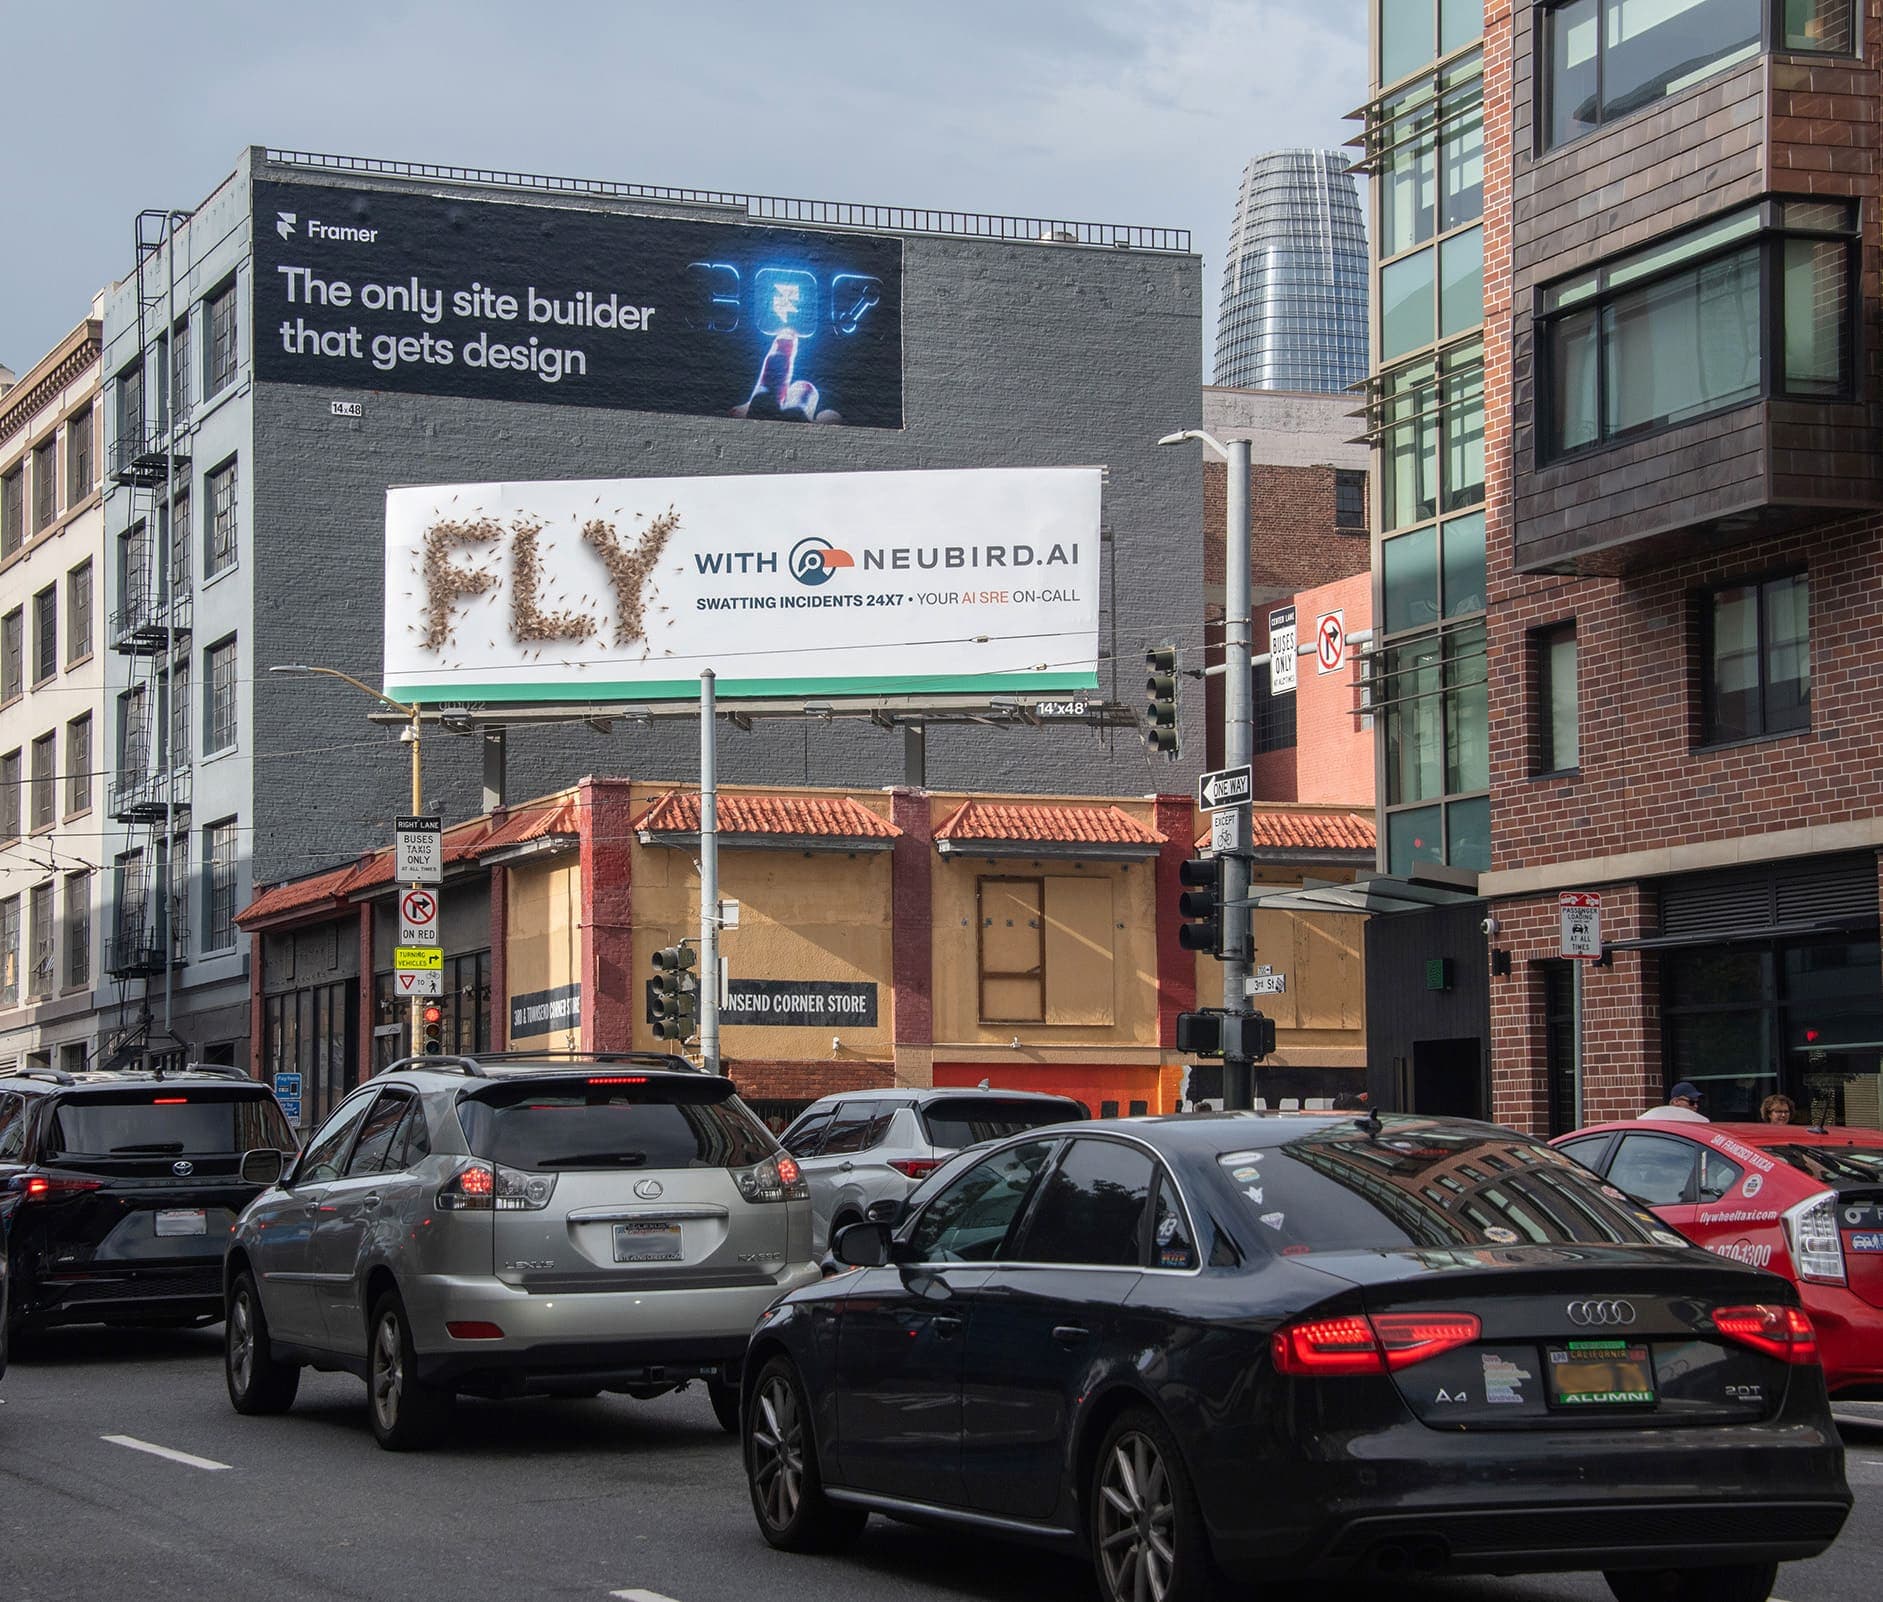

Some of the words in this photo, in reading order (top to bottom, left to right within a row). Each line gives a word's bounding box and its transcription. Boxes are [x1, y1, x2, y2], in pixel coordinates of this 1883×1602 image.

[308, 219, 378, 243] Framer
[277, 265, 352, 307] The
[361, 276, 443, 324] only
[453, 282, 519, 321] site
[528, 286, 656, 331] builder
[279, 318, 364, 359] that
[371, 332, 454, 371] gets
[463, 332, 587, 383] design
[333, 403, 361, 415] 14x48
[694, 551, 778, 575] WITH
[863, 543, 1079, 570] NEUBIRD.AI
[421, 509, 682, 652] FLY
[696, 596, 777, 611] SWATTING
[780, 595, 863, 609] INCIDENTS
[866, 593, 904, 607] 24X7
[917, 592, 959, 605] YOUR
[961, 592, 977, 605] AI
[979, 590, 1009, 604] SRE
[1012, 589, 1081, 603] ON-CALL
[1272, 632, 1294, 655] BUSES
[1275, 654, 1293, 675] ONLY
[1038, 701, 1088, 715] 14'x48'
[1213, 781, 1228, 798] ONE
[1229, 776, 1247, 794] WAY
[398, 821, 418, 829] RIGHT
[420, 821, 439, 829] LANE
[1215, 814, 1235, 828] EXCEPT
[404, 834, 434, 844] BUSES
[406, 845, 432, 854] TAXIS
[407, 855, 430, 864] ONLY
[403, 929, 415, 939] ON
[418, 929, 435, 939] RED
[1572, 943, 1590, 951] TIMES
[1267, 978, 1275, 990] St
[719, 994, 771, 1012] NSEND
[773, 994, 825, 1013] CORNER
[827, 995, 867, 1013] STORE
[1699, 1209, 1777, 1226] flywheeltaxi.com
[505, 1260, 555, 1270] LEXUS
[1434, 1388, 1467, 1403] A4
[1566, 1392, 1650, 1403] ALUMNI
